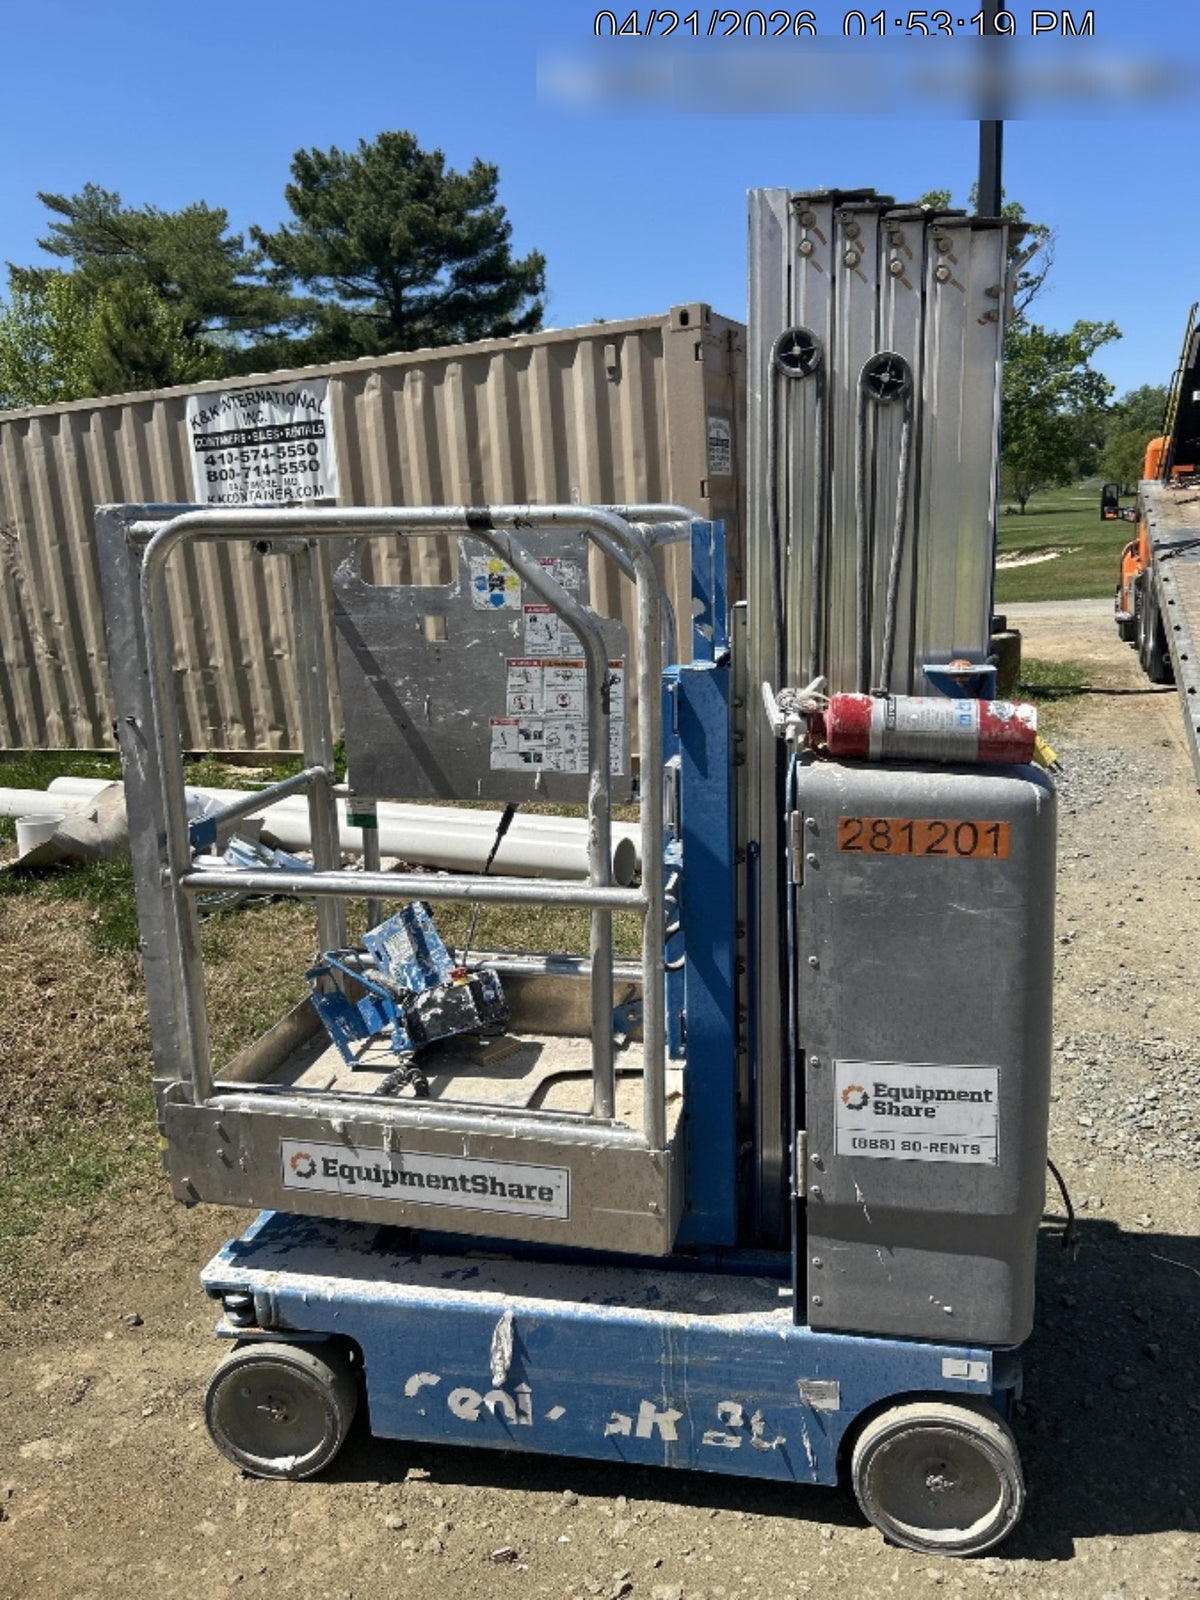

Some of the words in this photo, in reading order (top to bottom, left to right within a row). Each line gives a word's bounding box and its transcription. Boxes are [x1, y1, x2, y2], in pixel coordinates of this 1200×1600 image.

[190, 404, 220, 430] K&K
[221, 391, 326, 415] NTERNATIONAL
[243, 410, 268, 426] INC.
[204, 442, 319, 466] 410-574-5550
[840, 818, 1001, 857] 281201
[873, 1083, 993, 1104] Equipment
[873, 1100, 937, 1118] Share
[900, 1139, 982, 1155] 80-RENTS
[321, 1157, 554, 1202] EquipmentShare
